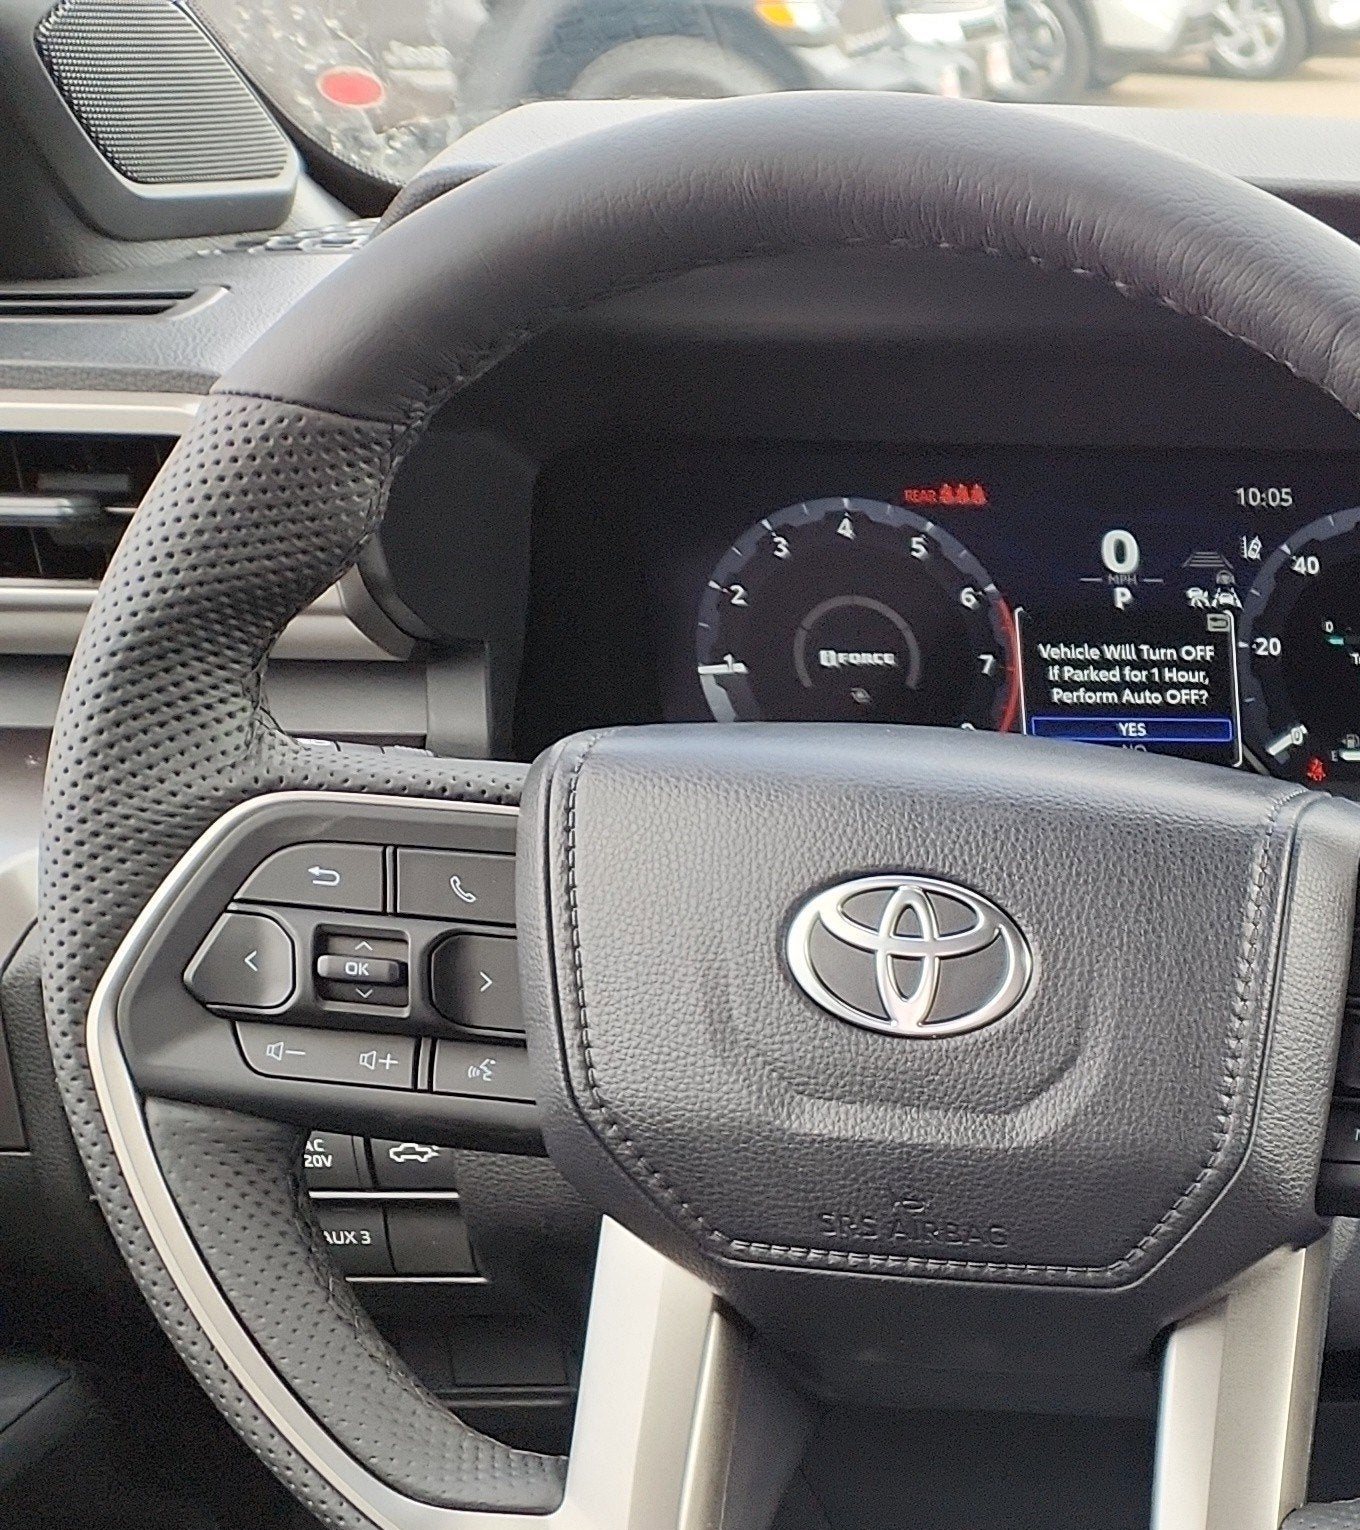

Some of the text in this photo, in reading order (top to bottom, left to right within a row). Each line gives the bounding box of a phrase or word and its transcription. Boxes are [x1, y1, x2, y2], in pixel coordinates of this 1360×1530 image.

[904, 489, 936, 502] REAR
[1236, 488, 1293, 507] 10:05
[837, 516, 854, 539] 4
[773, 536, 790, 558] 3
[911, 537, 928, 559] 5
[1101, 529, 1140, 574] 0
[1293, 555, 1320, 575] 40
[1108, 575, 1137, 585] MPH
[731, 585, 748, 606] 2
[960, 588, 979, 608] 6
[1114, 587, 1133, 610] P
[1324, 621, 1334, 633] 0
[1038, 643, 1215, 661] Vehicle Will Turn OFF
[1255, 637, 1281, 656] 20
[979, 654, 995, 676] 7
[1064, 667, 1120, 682] Parked
[1124, 667, 1148, 682] for
[1152, 667, 1159, 682] 1
[1164, 667, 1209, 685] Hour,
[1051, 689, 1209, 705] Perform Auto OFF?
[1117, 722, 1147, 737] YES
[1331, 751, 1338, 763] E
[344, 962, 370, 977] OK
[303, 1154, 333, 1168] 20V
[360, 1230, 371, 1245] 3
